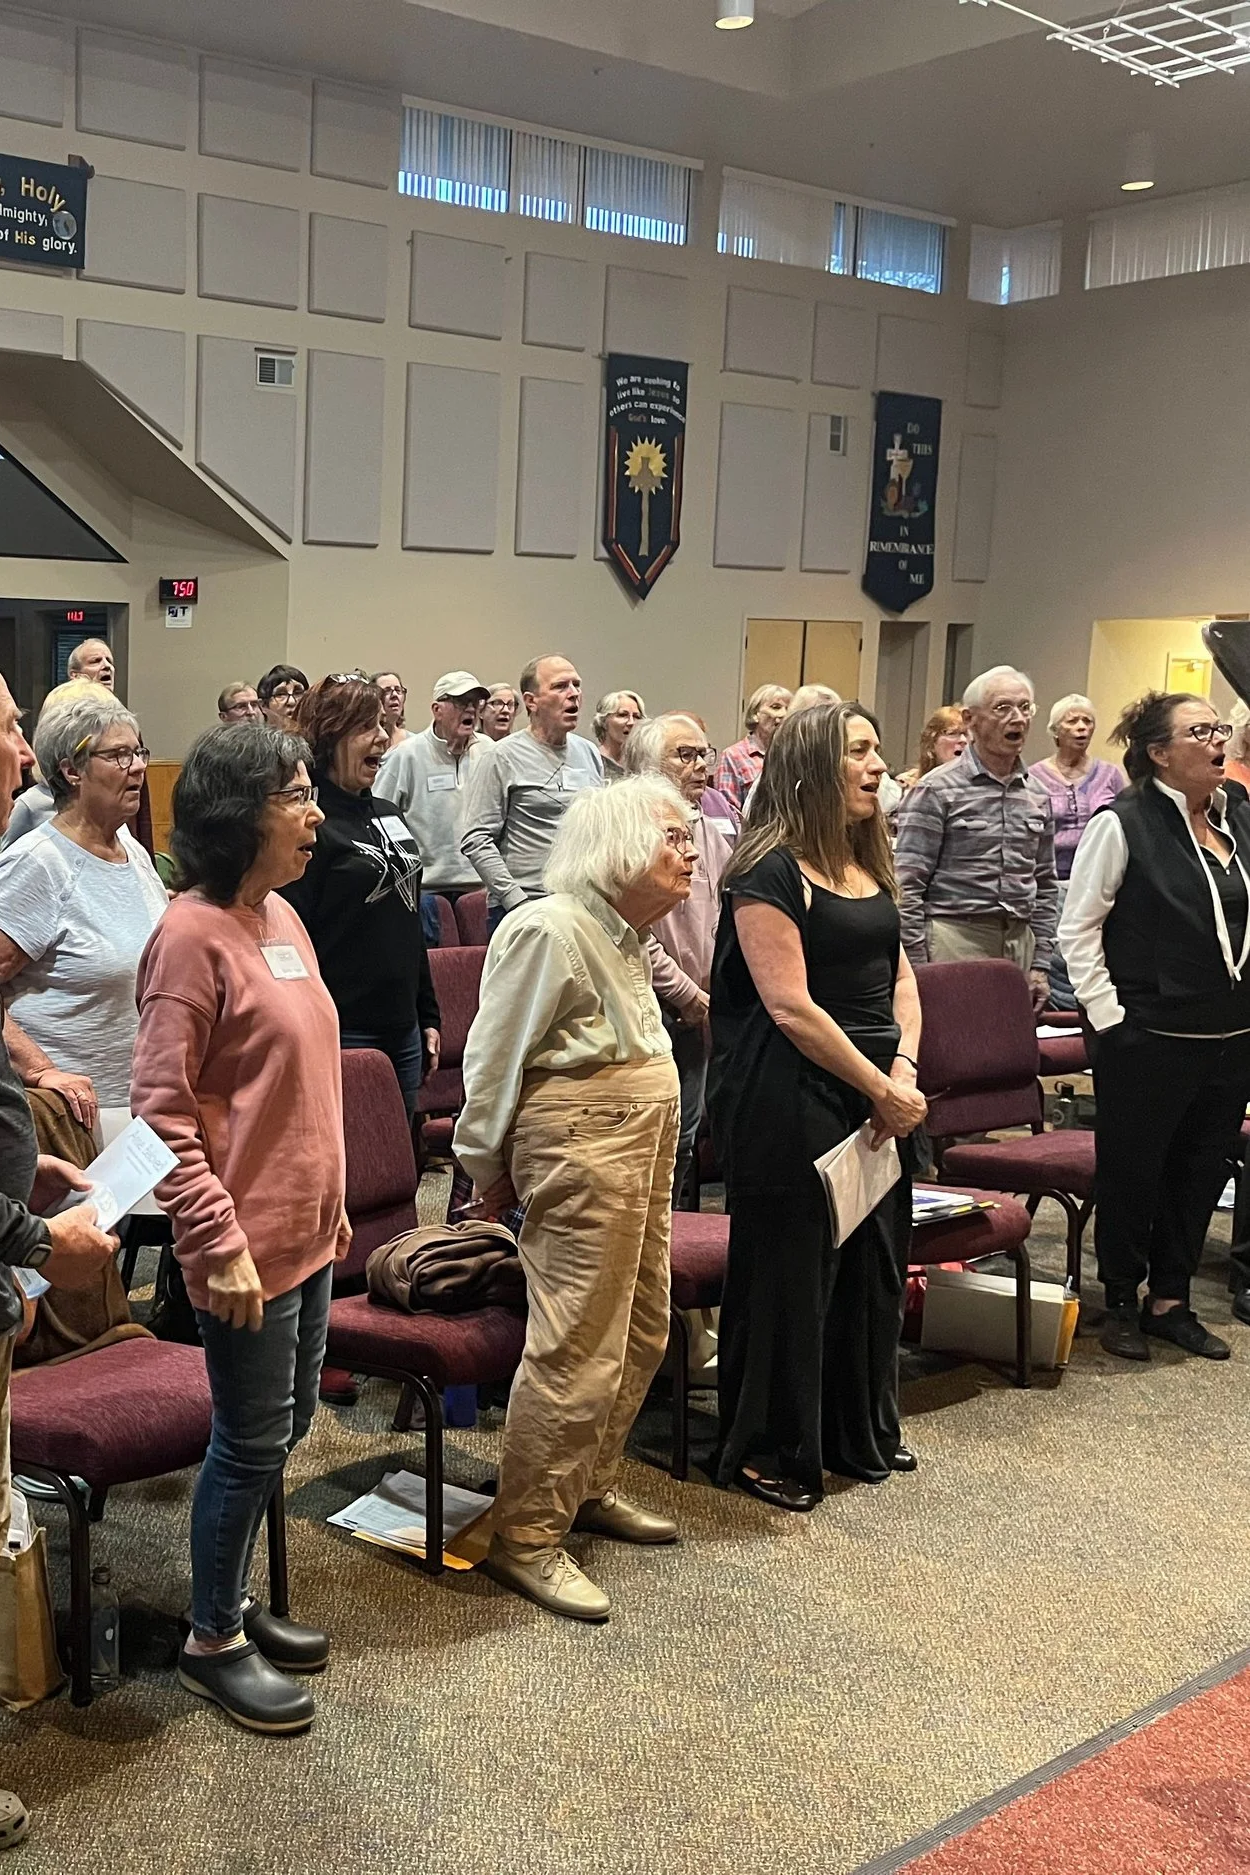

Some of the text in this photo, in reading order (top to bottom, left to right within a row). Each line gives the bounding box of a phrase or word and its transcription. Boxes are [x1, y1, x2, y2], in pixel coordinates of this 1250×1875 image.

[21, 176, 67, 213] Holy
[14, 230, 36, 246] His
[42, 237, 77, 255] glory.
[616, 377, 628, 387] We
[616, 389, 630, 400] live
[632, 387, 645, 396] like
[609, 401, 632, 417] others
[633, 401, 648, 409] can
[899, 525, 909, 537] IN
[910, 573, 924, 585] ME
